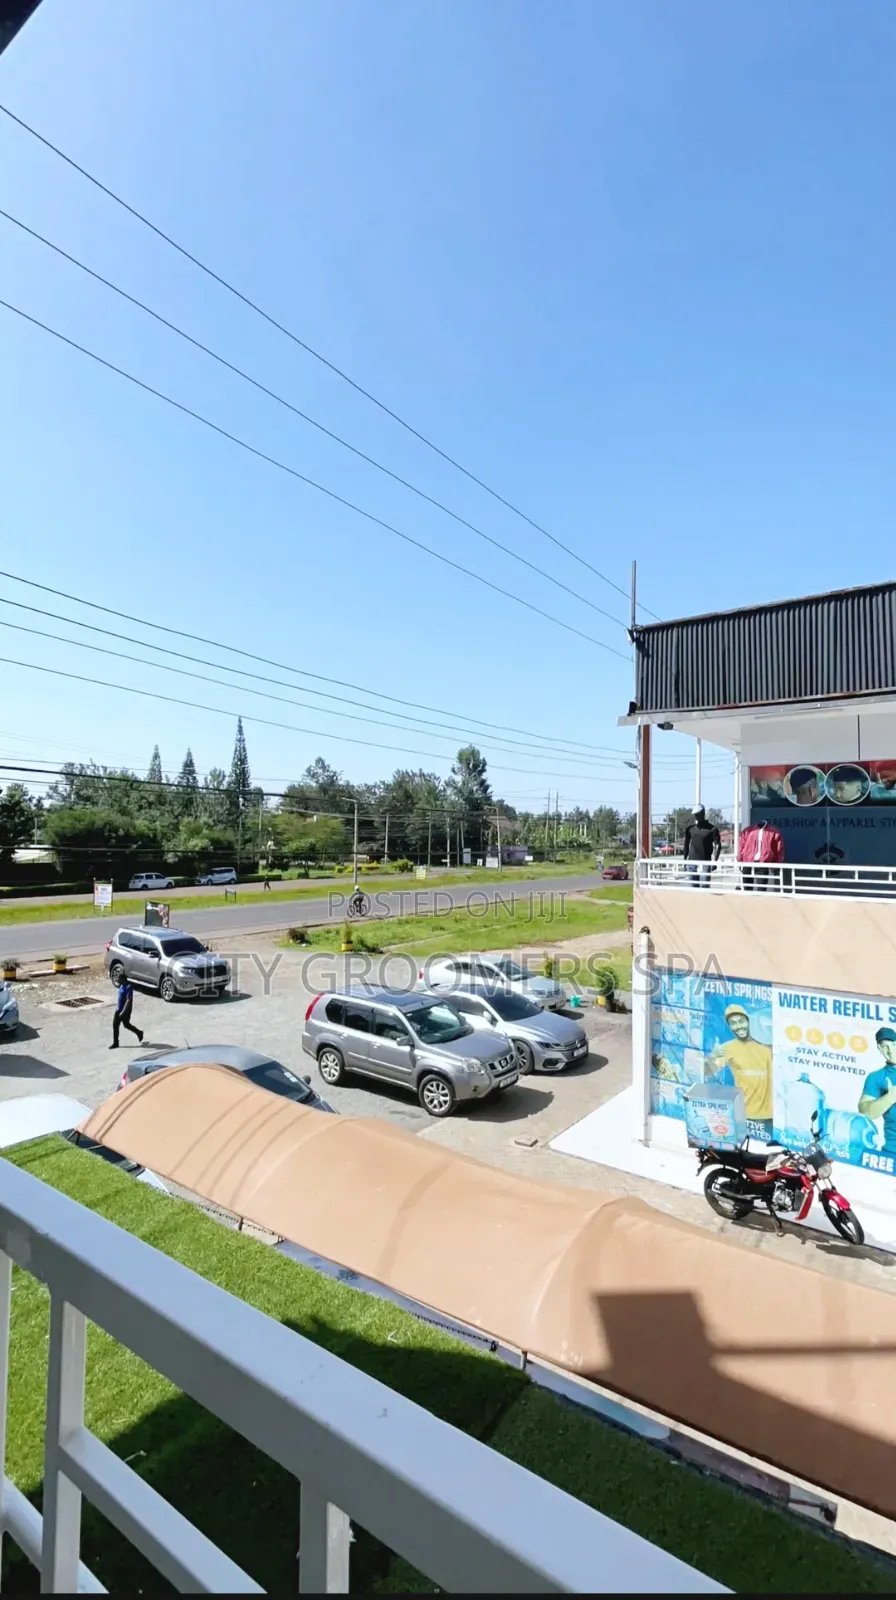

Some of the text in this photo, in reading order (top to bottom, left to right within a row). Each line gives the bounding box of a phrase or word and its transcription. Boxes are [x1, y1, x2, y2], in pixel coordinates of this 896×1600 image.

[829, 818, 876, 828] APPAREL
[778, 992, 828, 1013] WATER
[832, 999, 884, 1021] REFILL
[796, 1047, 857, 1063] STAY ACTIVE
[788, 1056, 866, 1076] STAY HYDRATED
[746, 1120, 765, 1131] TIVE
[862, 1152, 894, 1173] FREE
